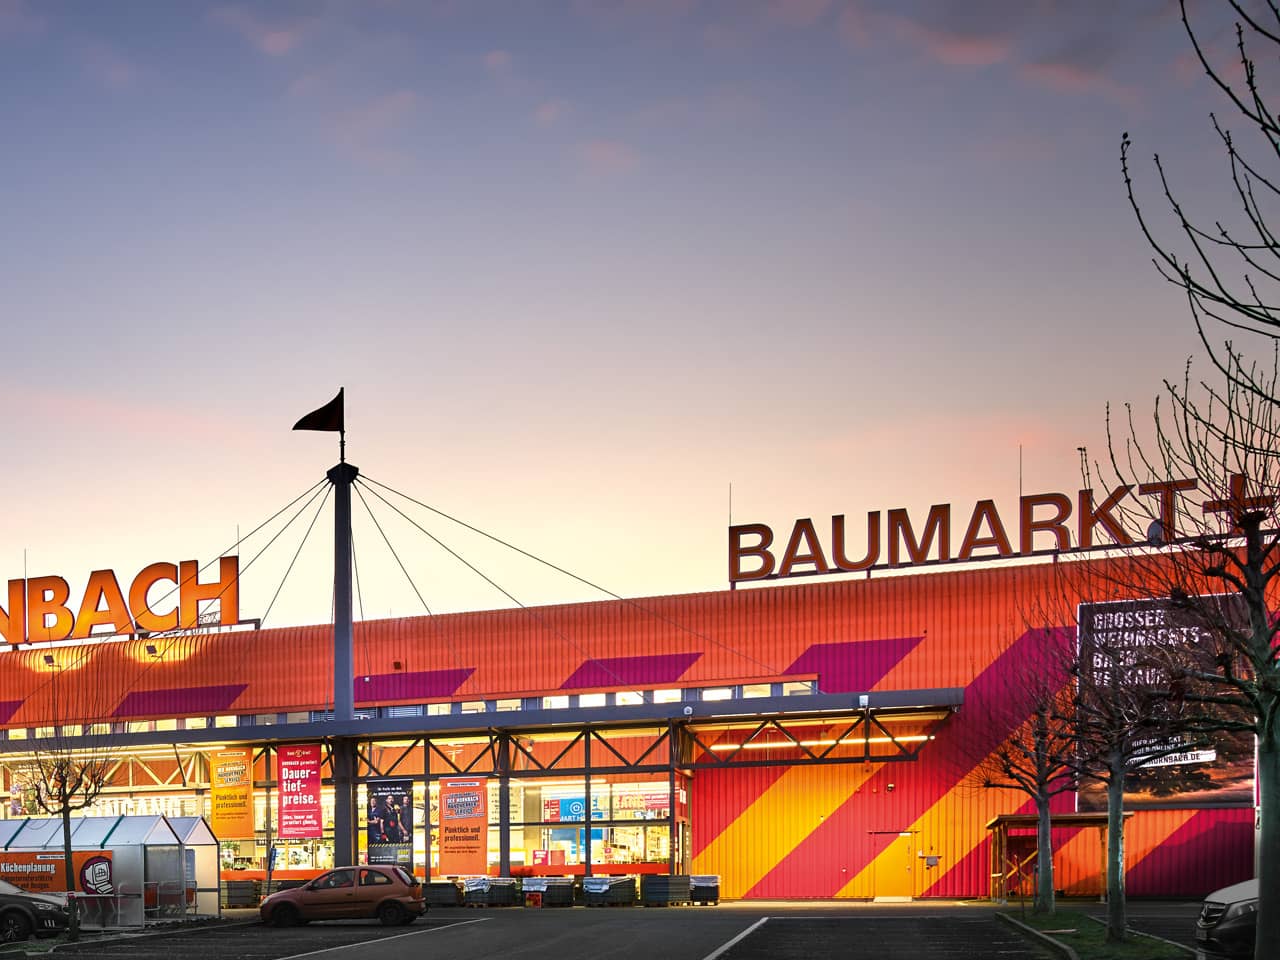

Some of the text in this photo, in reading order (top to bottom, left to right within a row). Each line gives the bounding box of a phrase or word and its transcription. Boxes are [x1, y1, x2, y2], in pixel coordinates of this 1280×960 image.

[282, 767, 317, 779] Dauer-
[282, 780, 307, 792] tief-
[282, 792, 318, 807] preise.
[444, 834, 480, 842] professionell.
[0, 862, 56, 874] Küchenplanung
